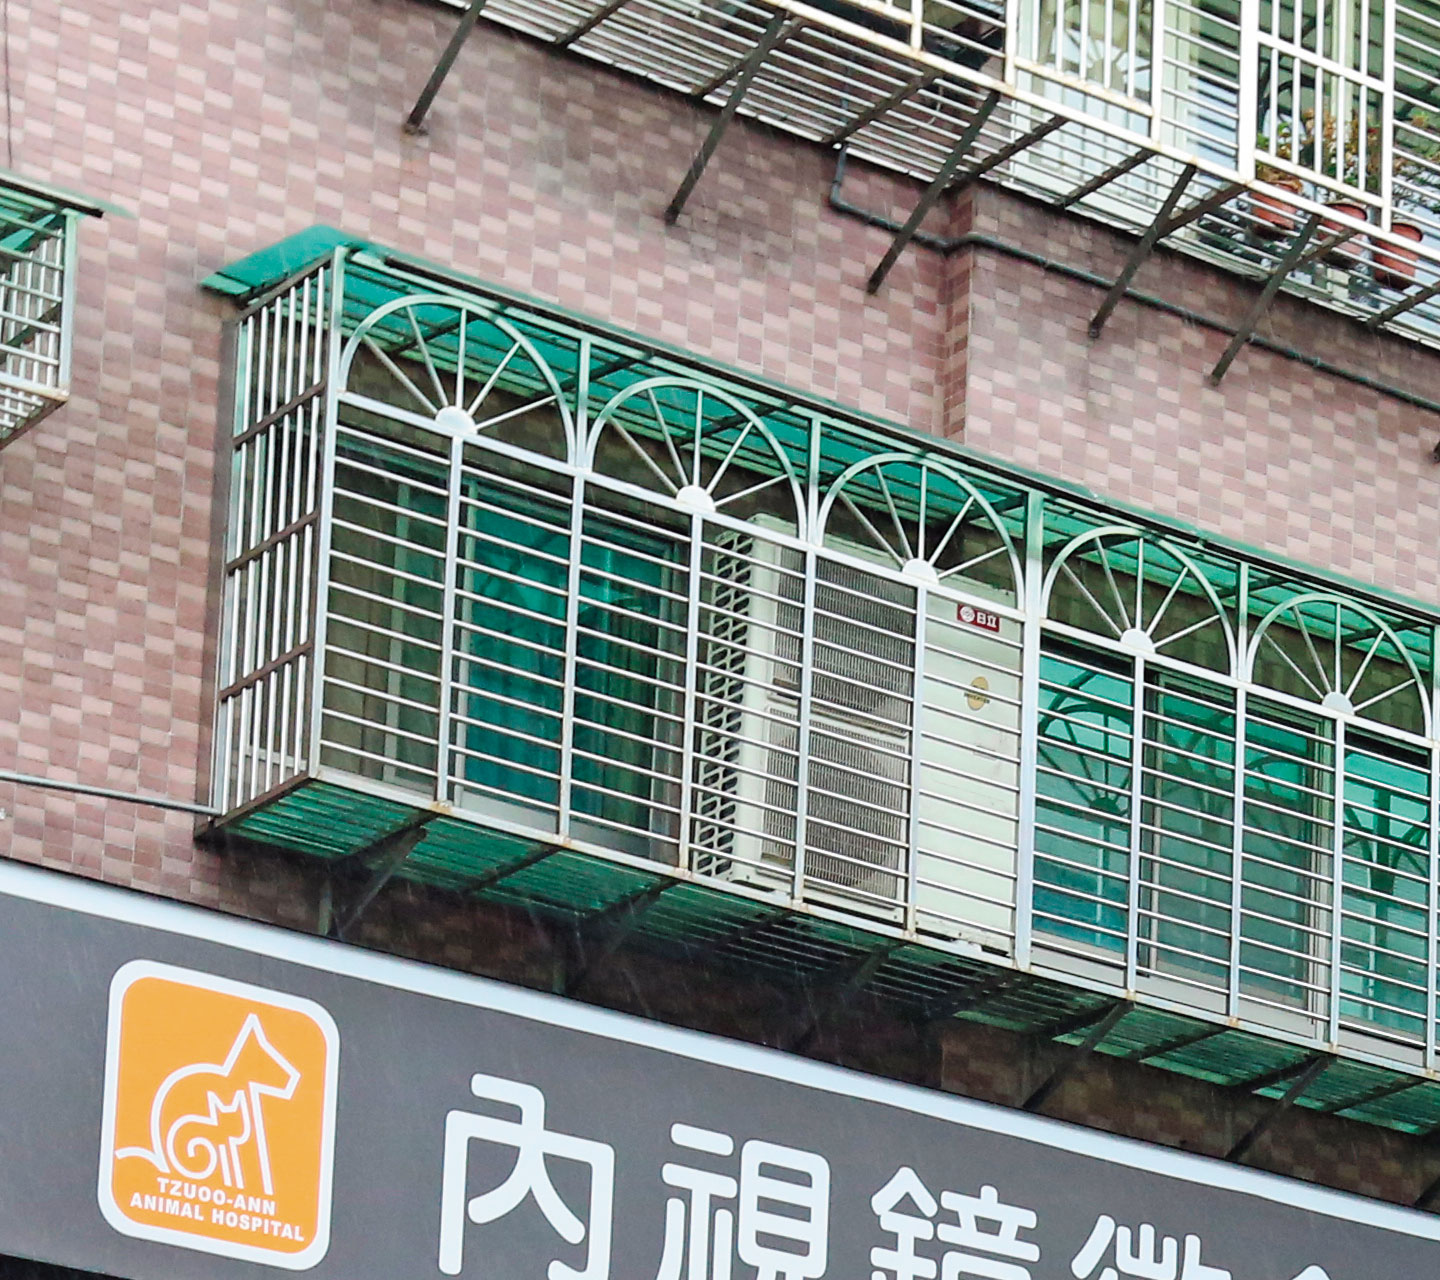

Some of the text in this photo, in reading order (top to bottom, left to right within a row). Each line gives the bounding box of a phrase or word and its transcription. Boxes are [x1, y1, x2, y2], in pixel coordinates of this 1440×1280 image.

[976, 611, 997, 628] 日立
[157, 1177, 276, 1216] TZUOO-ANN
[129, 1192, 305, 1242] ANIMAL HOSPITAL
